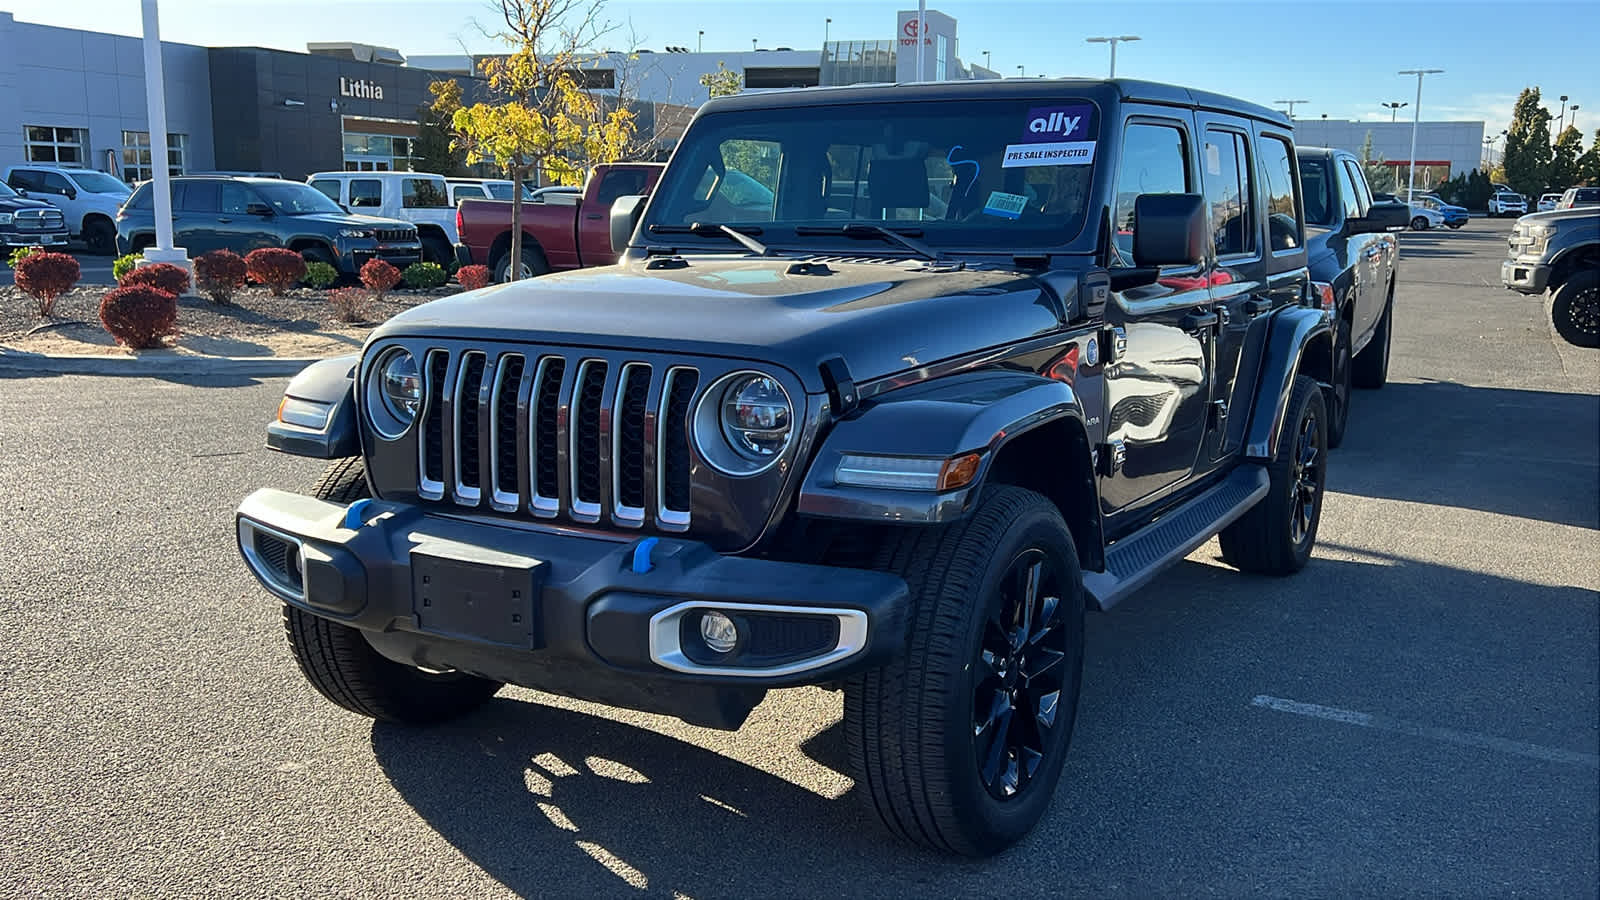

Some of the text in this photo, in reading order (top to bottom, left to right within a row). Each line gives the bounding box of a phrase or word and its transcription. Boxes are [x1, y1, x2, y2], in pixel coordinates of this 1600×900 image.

[900, 38, 932, 46] TOYTA
[340, 76, 384, 100] Lithia
[1029, 112, 1081, 136] ally
[1007, 149, 1089, 160] PRE SALE INSPECTED
